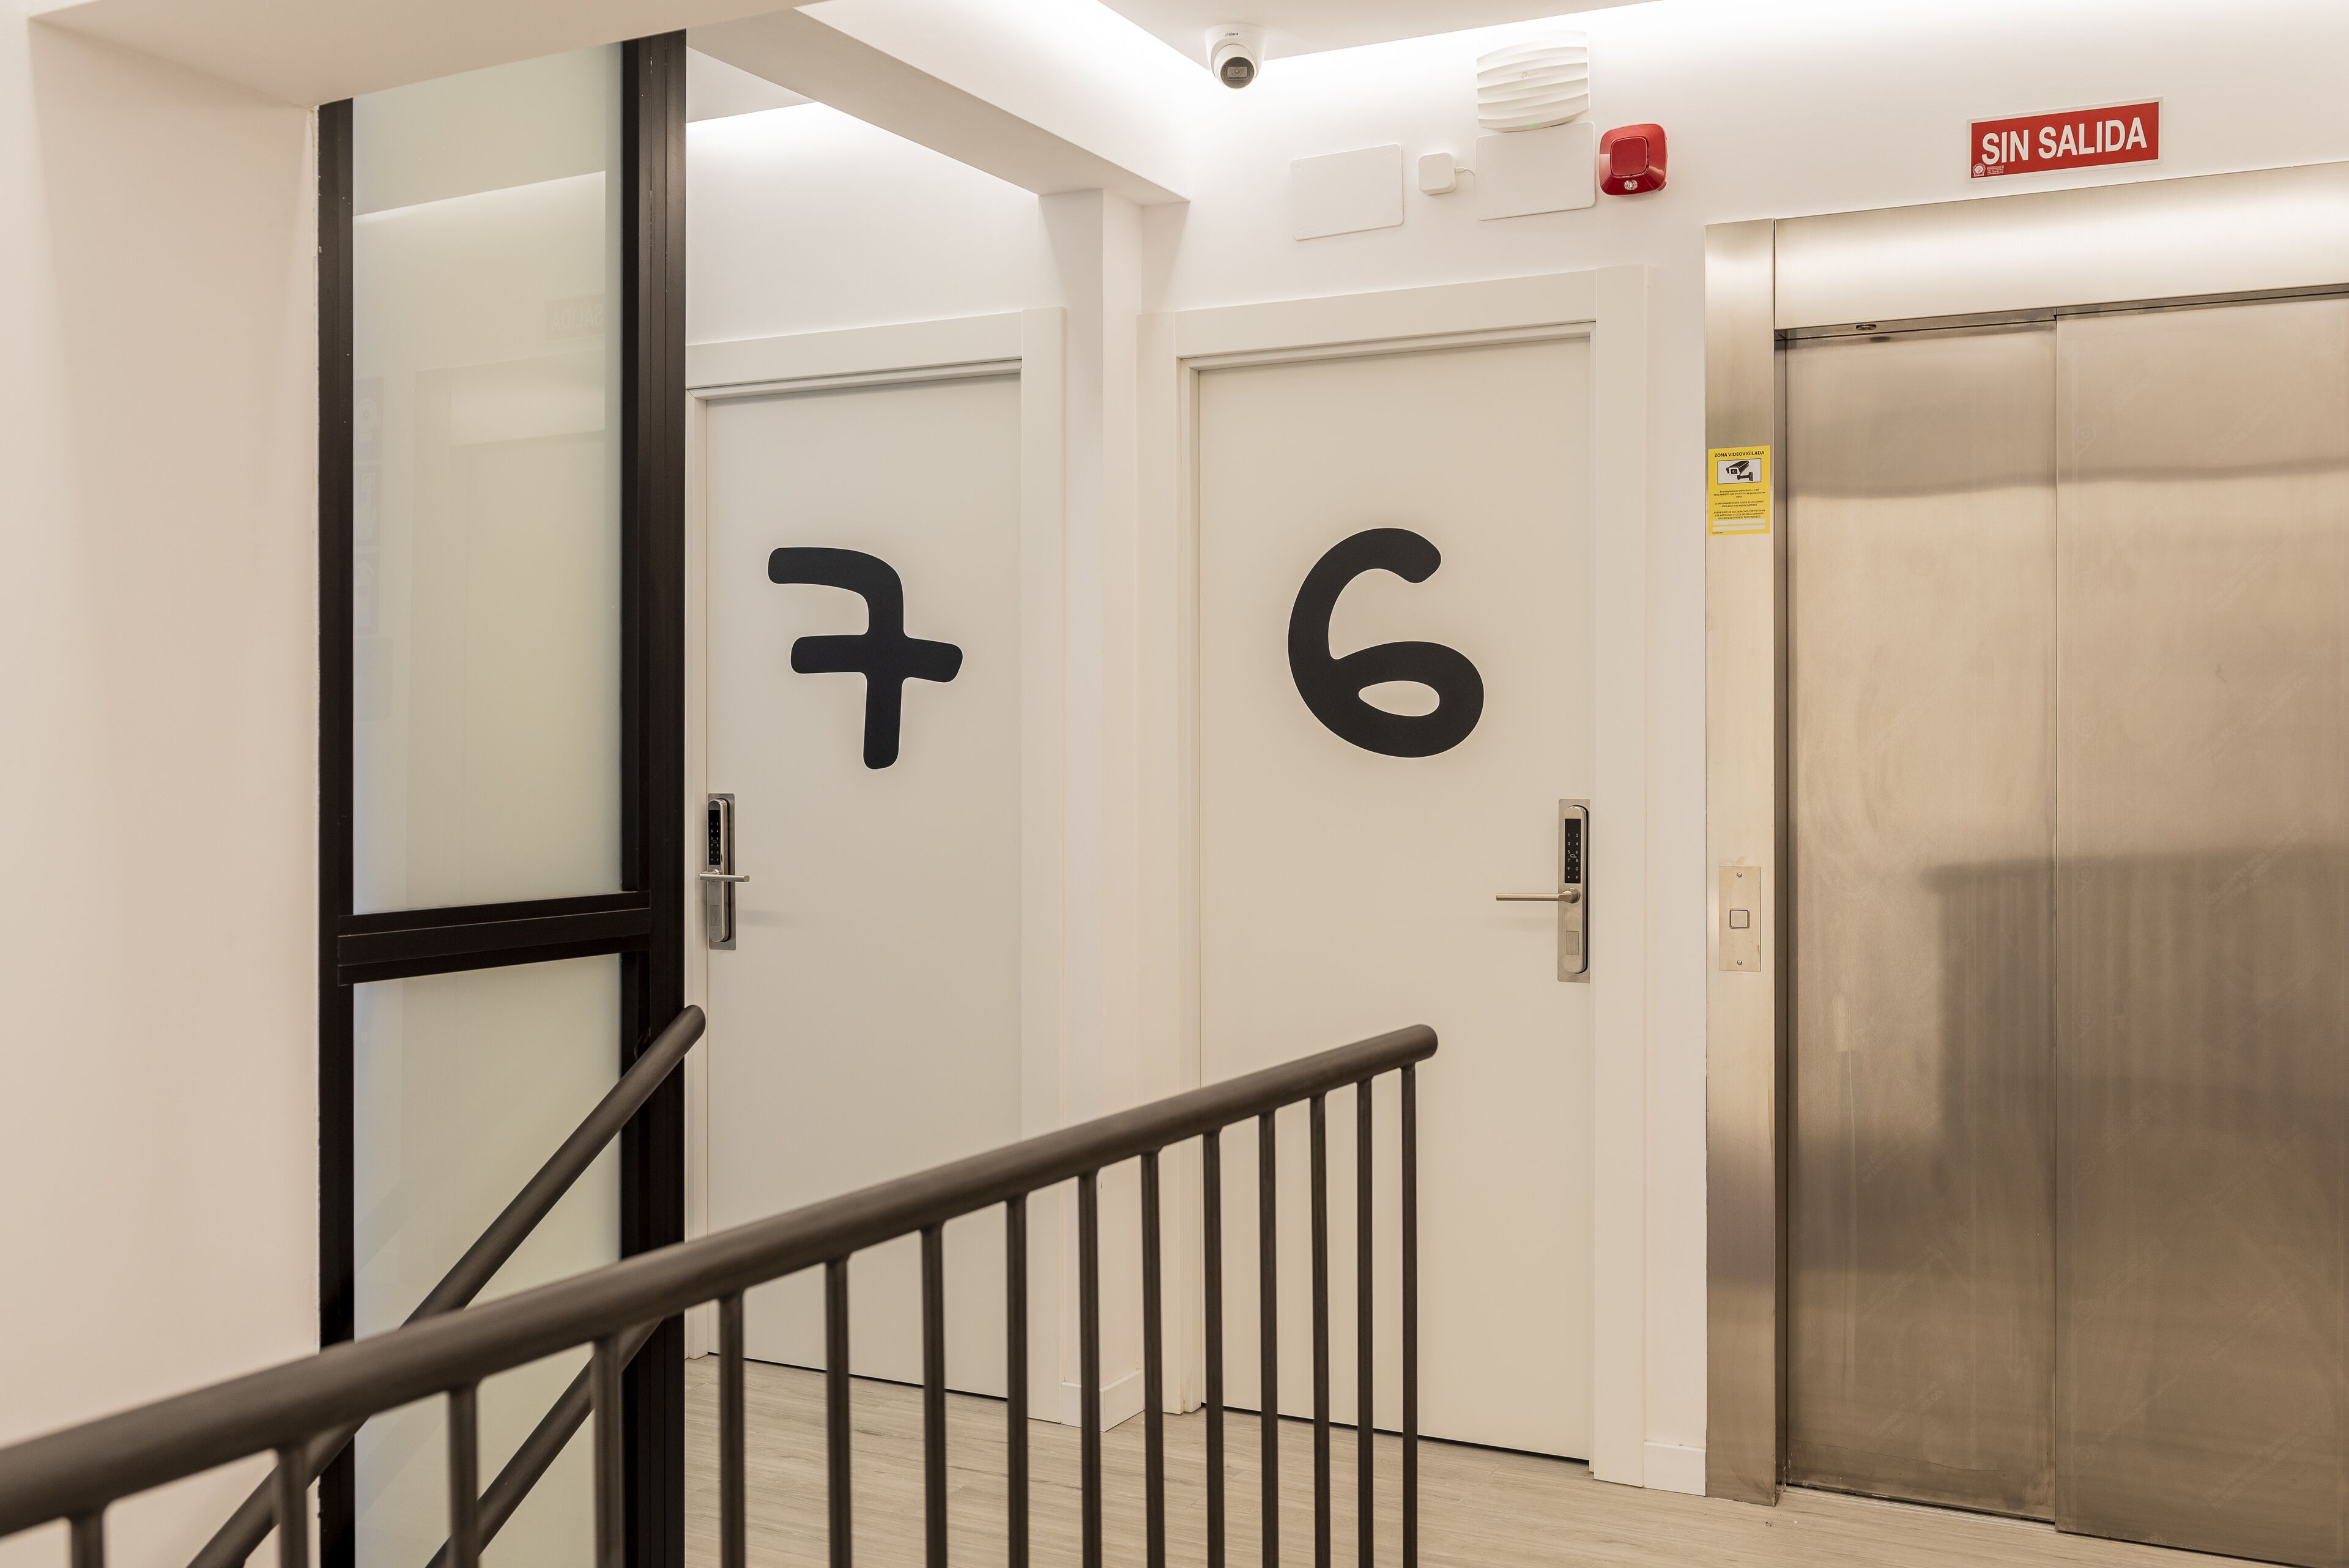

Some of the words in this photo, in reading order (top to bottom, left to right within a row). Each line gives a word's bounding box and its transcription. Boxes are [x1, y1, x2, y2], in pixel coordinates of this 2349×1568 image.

[1981, 129, 2029, 165] SIN
[2038, 117, 2148, 159] SALIDA
[768, 547, 963, 770] 7
[1288, 527, 1483, 758] 6
